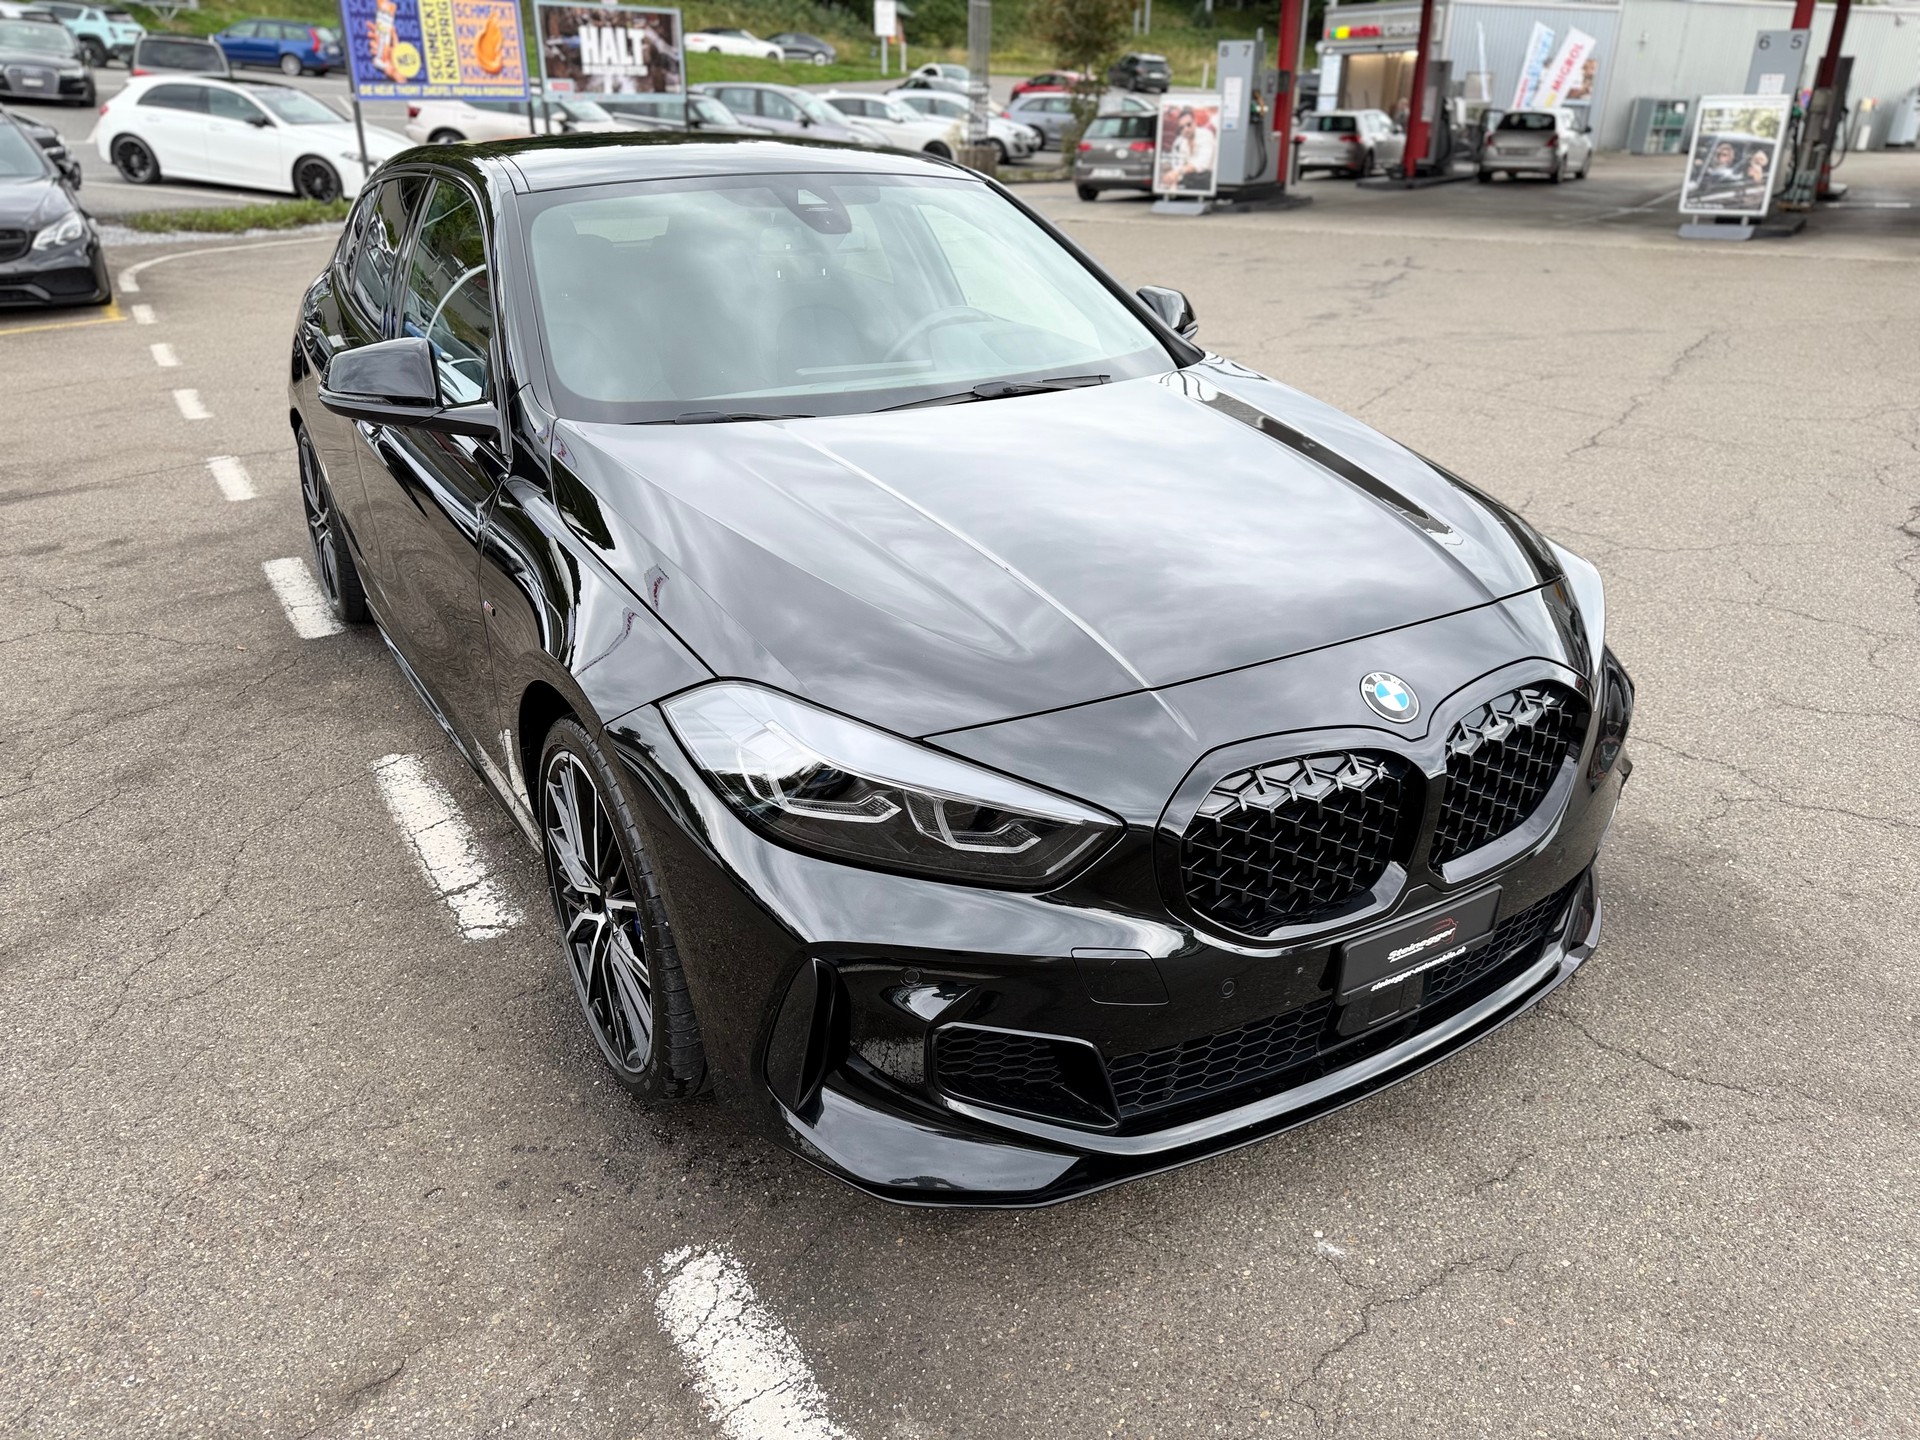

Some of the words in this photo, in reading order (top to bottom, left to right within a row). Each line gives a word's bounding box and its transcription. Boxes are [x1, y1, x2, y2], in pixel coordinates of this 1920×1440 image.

[422, 1, 443, 79] SCHMECKT
[436, 0, 457, 80] KNUSPRIG
[578, 24, 645, 66] HALT
[1220, 45, 1229, 58] 8
[1242, 44, 1251, 58] 7
[1758, 34, 1771, 50] 6
[1790, 34, 1803, 50] 5
[1551, 43, 1584, 92] MIGROL
[1387, 927, 1456, 961] Steinegger
